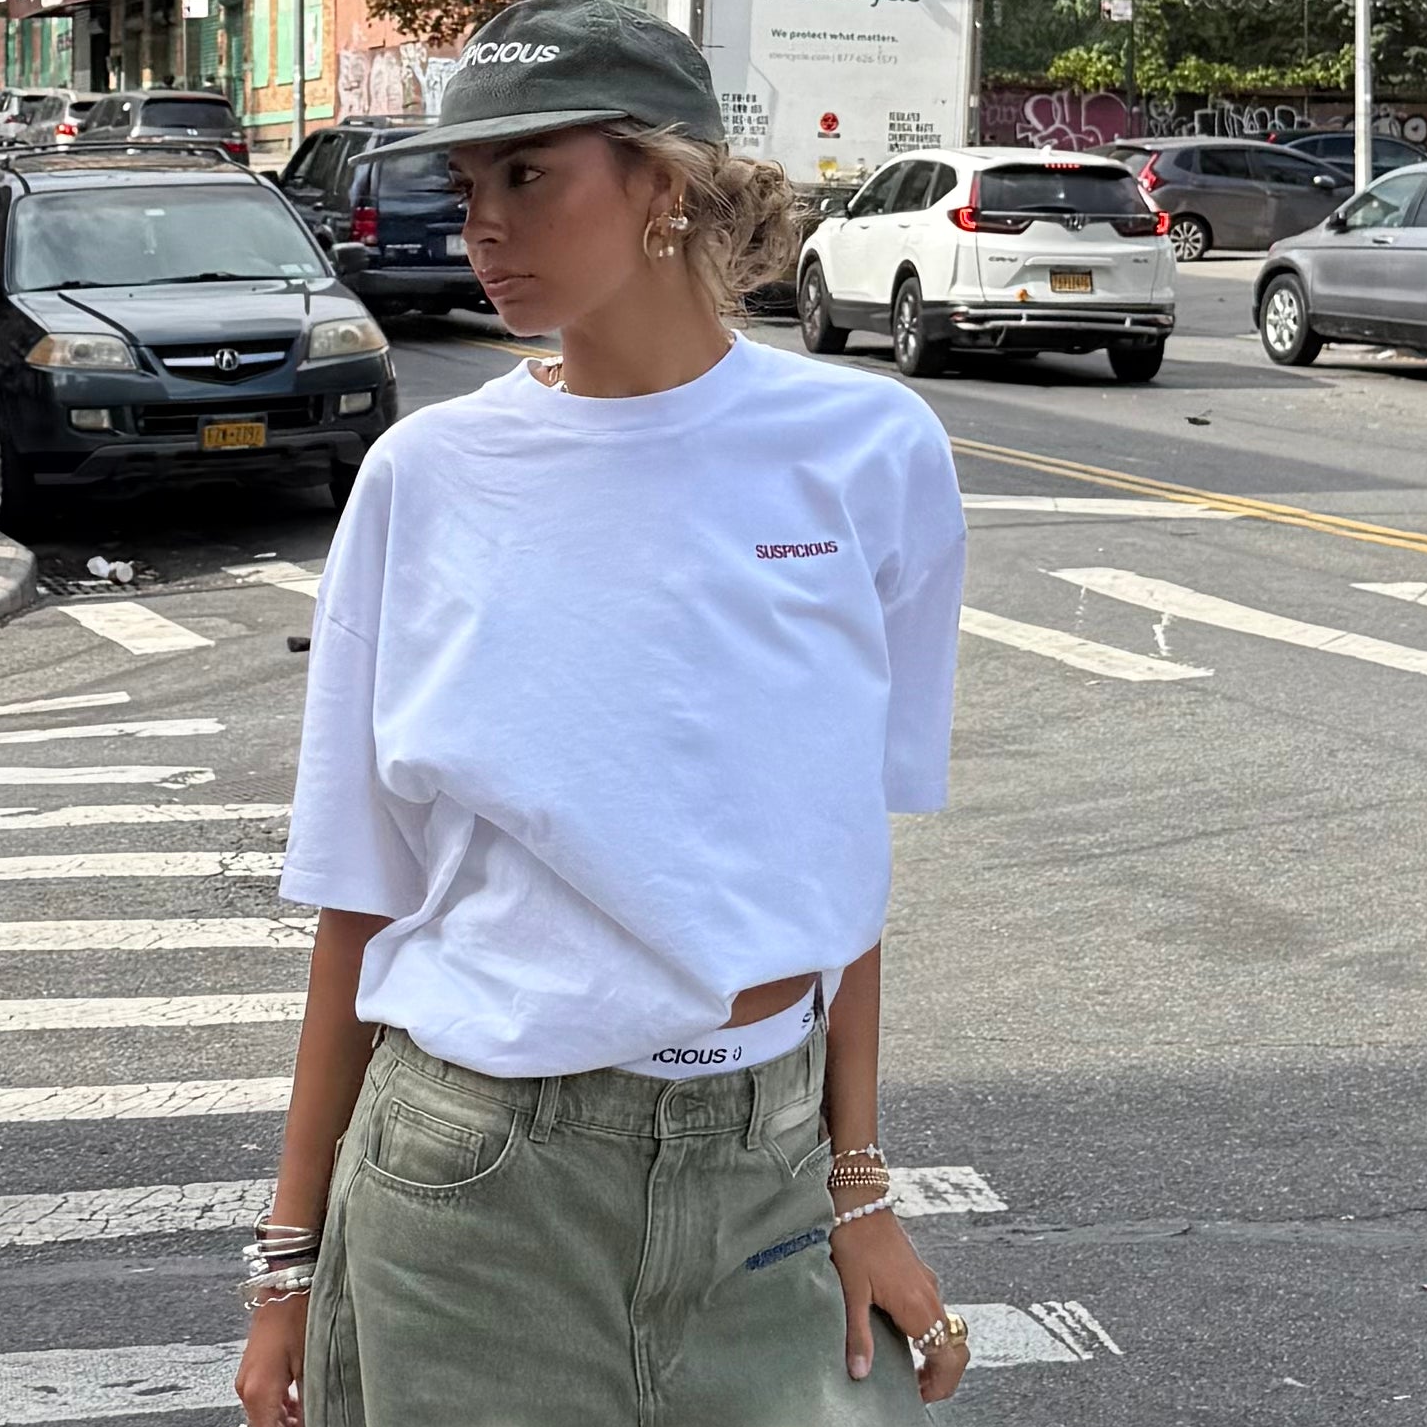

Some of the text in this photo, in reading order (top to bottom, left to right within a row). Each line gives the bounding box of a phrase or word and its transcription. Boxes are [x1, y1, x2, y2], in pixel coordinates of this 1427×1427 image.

[771, 28, 787, 38] We
[789, 31, 828, 40] protect
[829, 32, 855, 41] what
[755, 540, 839, 560] SUSPICIOUS
